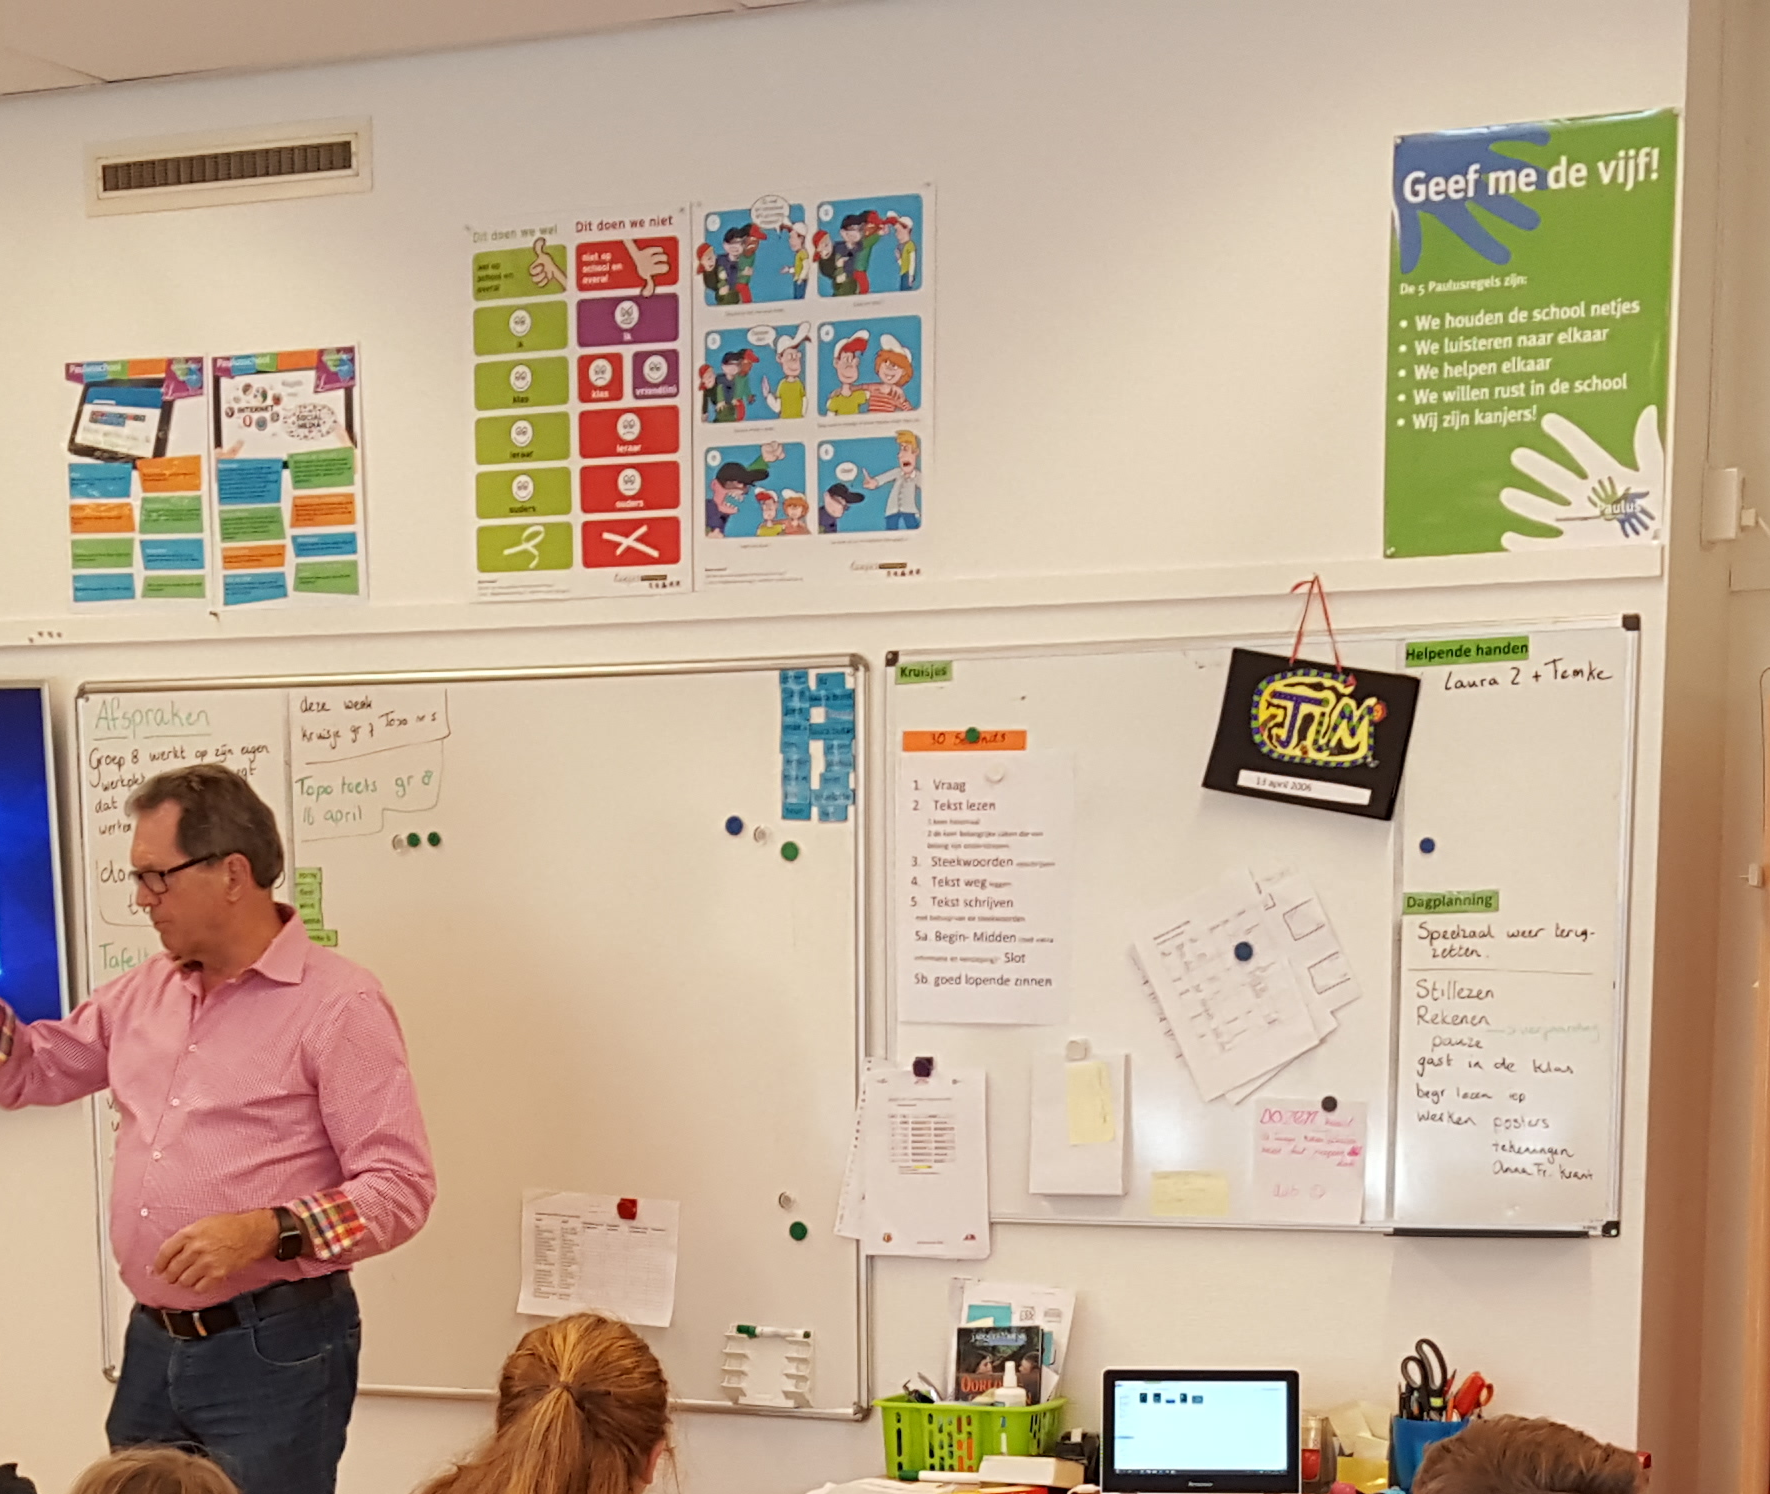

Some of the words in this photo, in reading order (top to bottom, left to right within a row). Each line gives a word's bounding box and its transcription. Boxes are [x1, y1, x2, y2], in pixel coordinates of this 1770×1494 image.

[1403, 165, 1480, 203] Geef
[1488, 168, 1536, 195] me
[1546, 157, 1588, 190] de
[1597, 147, 1660, 192] vijf!
[473, 231, 487, 243] Dit
[491, 229, 517, 241] doen
[520, 228, 535, 237] we
[539, 224, 557, 235] wel
[575, 220, 592, 233] Dit
[597, 220, 625, 231] doen
[630, 219, 645, 228] we
[649, 215, 673, 226] niet
[1399, 282, 1415, 296] De
[1417, 284, 1425, 296] 5
[1503, 272, 1528, 288] zijn:
[1415, 313, 1441, 331] We
[1445, 308, 1504, 329] houden
[1508, 305, 1528, 323] de
[1532, 301, 1586, 321] school
[1590, 298, 1640, 318] netjes
[1414, 338, 1440, 355] We
[1444, 333, 1512, 354] luisteren
[1517, 331, 1553, 348] naar
[1556, 326, 1609, 345] elkaar
[1414, 363, 1440, 380] We
[1443, 358, 1497, 381] helpen
[1501, 354, 1552, 374] elkaar
[1413, 387, 1439, 405] We
[1442, 383, 1489, 402] willen
[1494, 381, 1525, 399] rust
[1530, 378, 1544, 396] in
[1550, 376, 1570, 395] de
[1574, 373, 1628, 393] school
[1412, 411, 1438, 431] Wij
[1442, 409, 1470, 429] zijn
[1474, 405, 1537, 428] kanjers!
[1596, 499, 1642, 514] Paulus
[1406, 646, 1471, 662] Helpende
[1476, 642, 1529, 656] handen
[900, 664, 947, 680] Kruisjes
[1445, 671, 1499, 691] Laura
[95, 697, 211, 738] Afspraken
[89, 747, 126, 788] Groep
[132, 751, 139, 765] 8
[149, 746, 186, 763] werkt
[195, 751, 207, 764] op
[295, 775, 333, 802] Topo
[341, 776, 378, 795] toets
[395, 775, 414, 799] gr
[422, 770, 434, 786] 8
[933, 780, 966, 793] Vraag
[1268, 779, 1289, 789] april
[95, 799, 119, 814] dat
[323, 805, 363, 824] april
[933, 799, 963, 812] Tekst
[966, 799, 996, 812] lezen
[931, 855, 1014, 868] Steekwoorden
[932, 876, 961, 888] Tekst
[964, 878, 988, 890] weg
[931, 896, 960, 908] Tekst
[963, 896, 1014, 910] schrijven
[1407, 894, 1493, 910] Dagplanning
[934, 931, 969, 945] Begin-
[973, 931, 1017, 943] Midden
[1418, 922, 1495, 943] Speelzaal
[1507, 928, 1545, 939] weer
[1004, 952, 1026, 964] Slot
[933, 973, 962, 988] goed
[965, 973, 1011, 988] lopende
[1014, 976, 1053, 987] zinnen
[1416, 979, 1495, 1001] Stillezen
[1416, 1005, 1491, 1027] Rekenen
[1431, 1035, 1484, 1052] pauze
[1417, 1053, 1454, 1077] gast
[1468, 1060, 1483, 1070] in
[1494, 1057, 1517, 1073] de
[1532, 1058, 1574, 1074] klas
